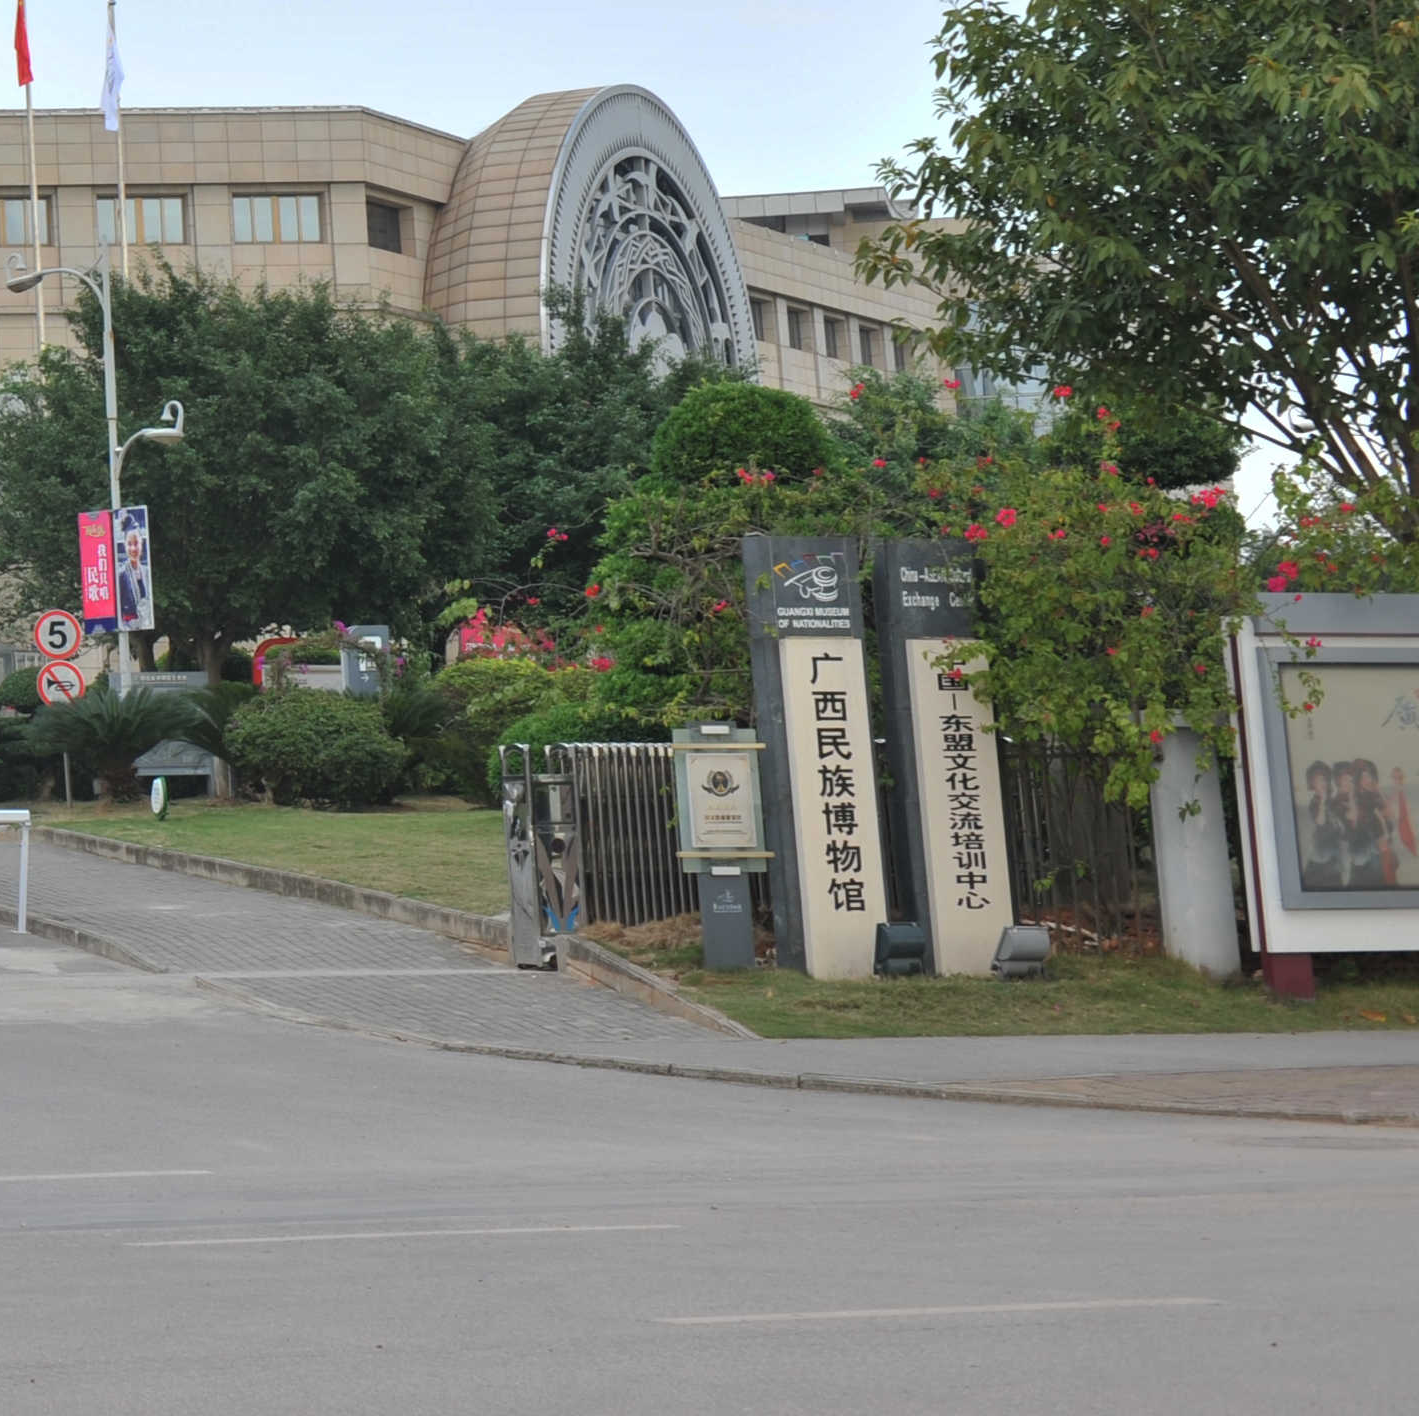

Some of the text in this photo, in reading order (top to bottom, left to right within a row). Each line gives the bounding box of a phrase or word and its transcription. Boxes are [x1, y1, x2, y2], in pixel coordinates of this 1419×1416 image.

[902, 590, 940, 611] Exchange
[777, 607, 850, 617] GUANGXI MUSEUM
[778, 618, 851, 629] OF NATIONALITIES
[48, 621, 67, 649] 5
[810, 652, 866, 912] 广西民族博物馆
